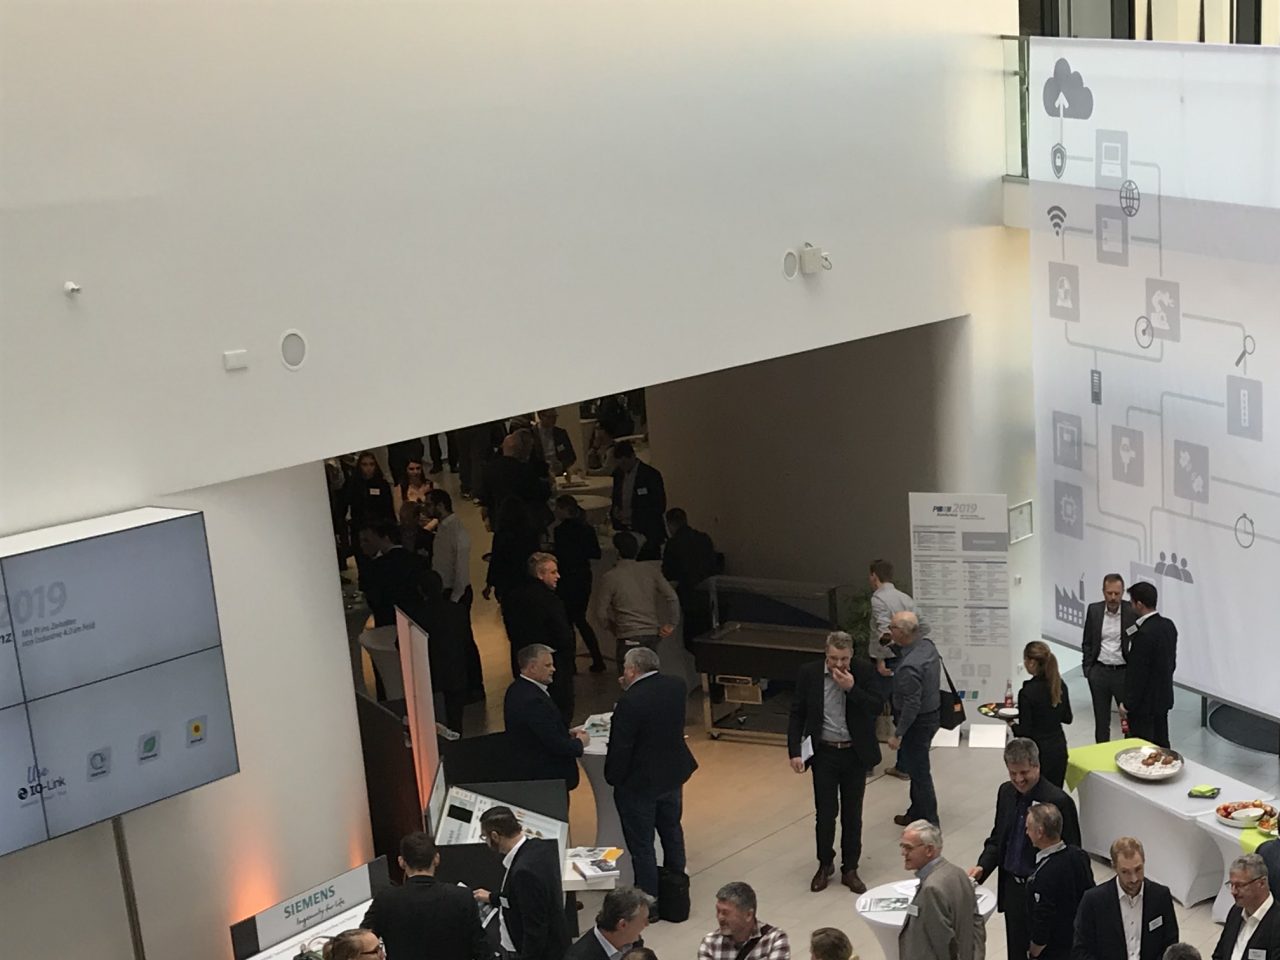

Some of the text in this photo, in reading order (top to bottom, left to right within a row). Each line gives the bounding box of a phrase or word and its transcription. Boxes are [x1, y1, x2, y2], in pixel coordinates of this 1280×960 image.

[952, 503, 978, 514] 2019
[27, 766, 49, 784] Ue
[283, 885, 336, 919] SIEMENS
